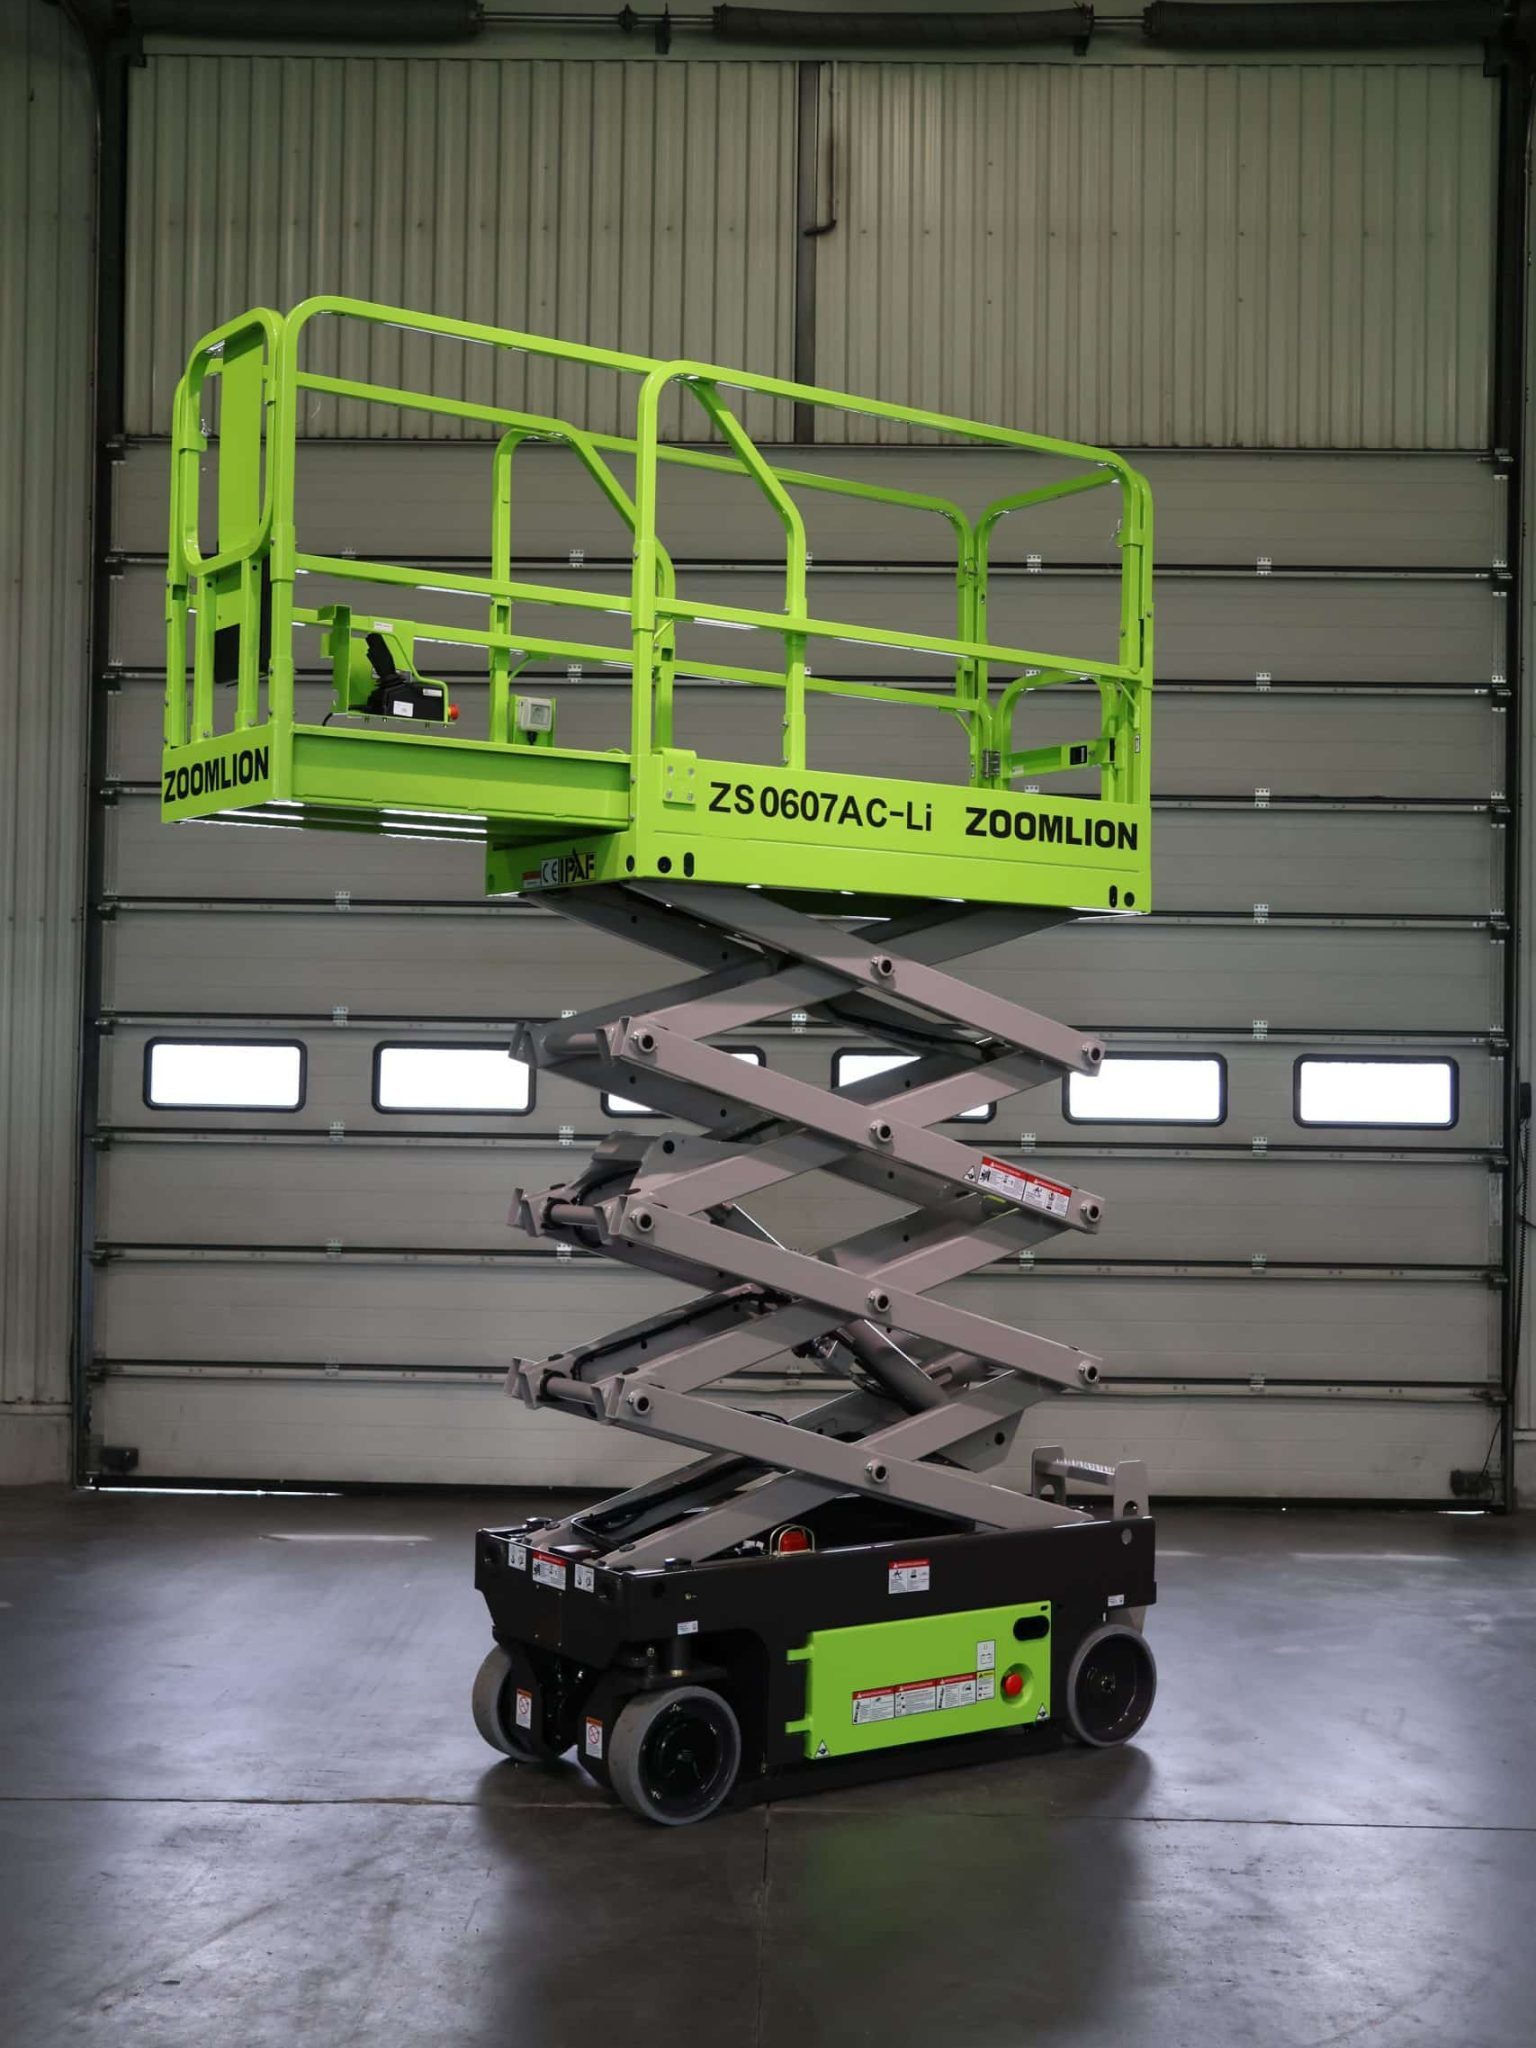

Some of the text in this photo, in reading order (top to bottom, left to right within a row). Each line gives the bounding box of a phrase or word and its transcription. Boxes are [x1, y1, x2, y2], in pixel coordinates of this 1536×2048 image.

[164, 746, 269, 803] ZOOMLION
[708, 781, 932, 832] ZS0607AC-Li
[965, 807, 1138, 850] ZOOMLION
[560, 847, 595, 883] IPAF
